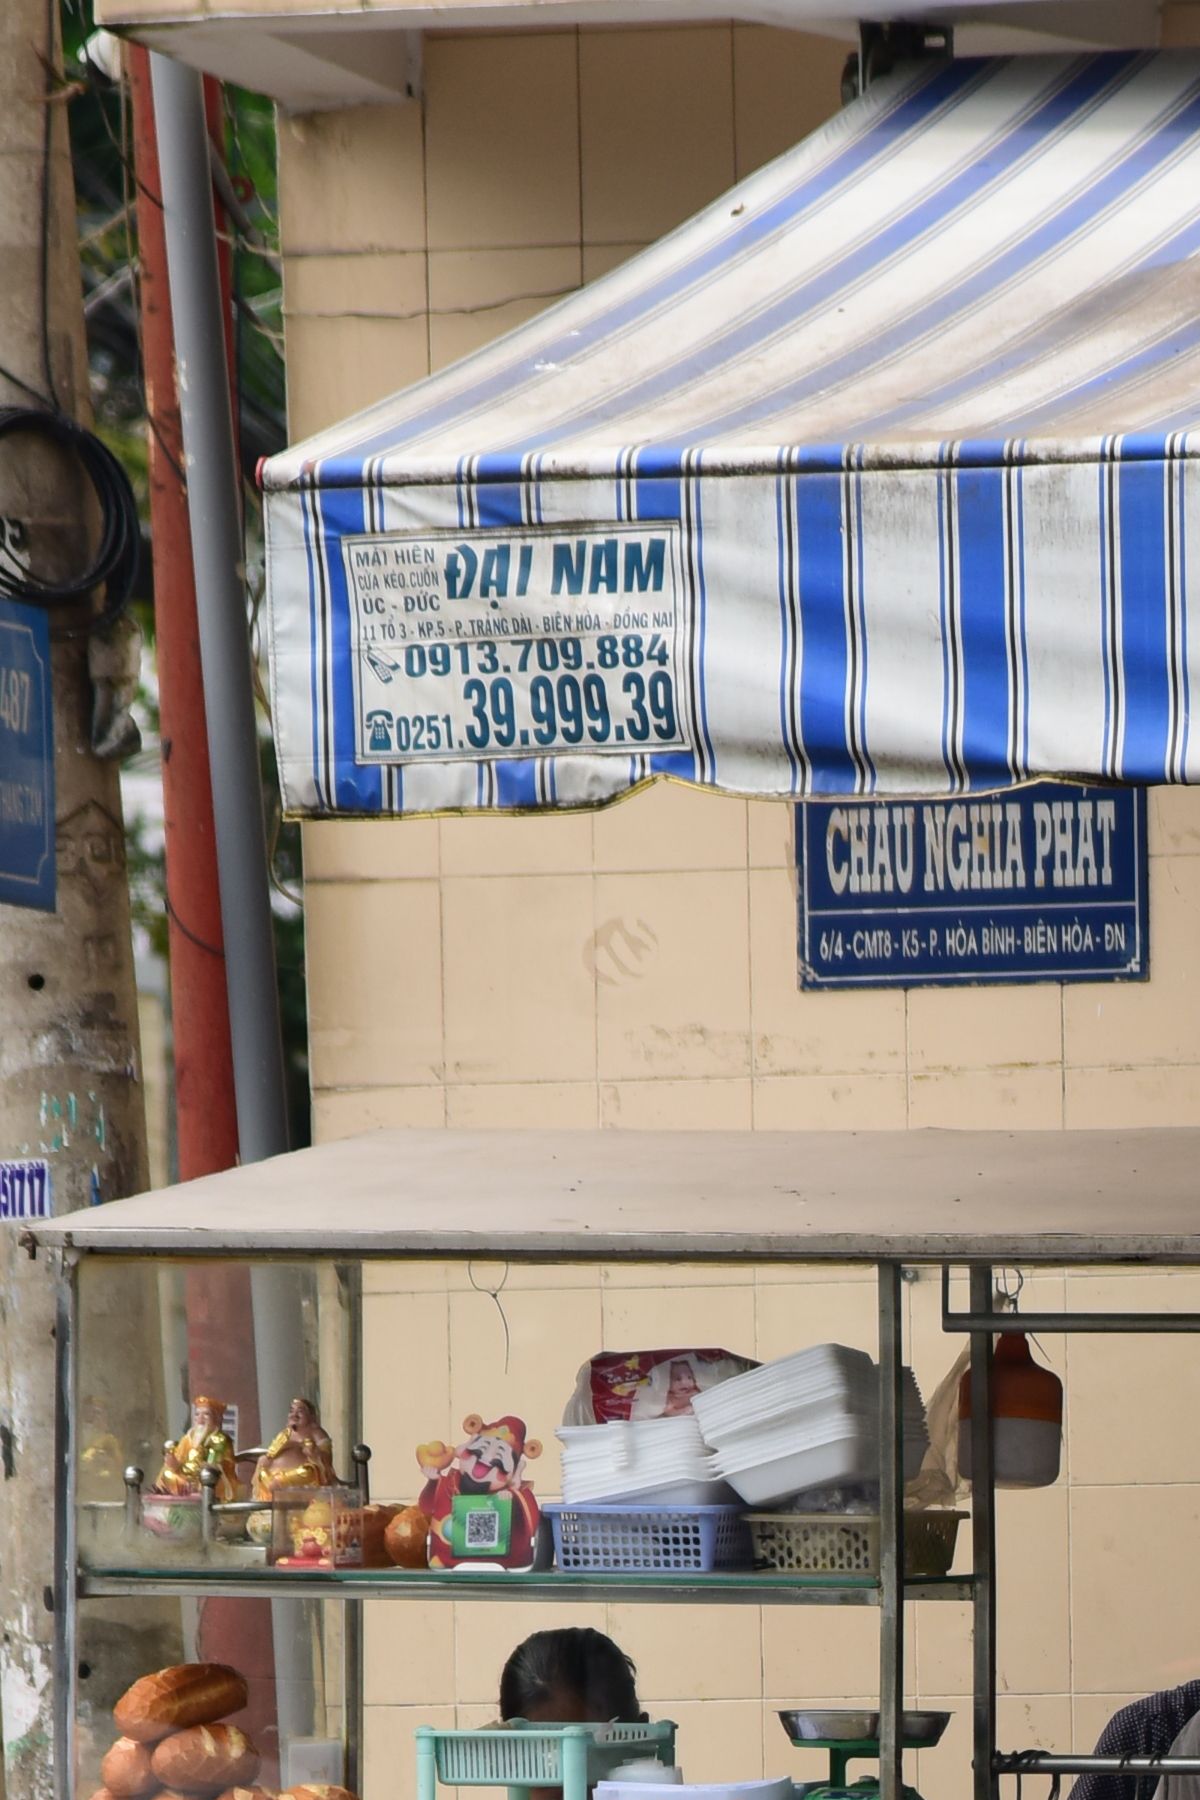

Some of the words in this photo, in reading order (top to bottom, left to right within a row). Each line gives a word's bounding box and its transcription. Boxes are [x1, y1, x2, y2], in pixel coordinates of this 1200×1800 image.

[395, 545, 435, 564] HIÊN
[444, 543, 533, 609] ĐẠI
[551, 539, 666, 595] NAM
[363, 625, 375, 640] 11
[400, 622, 407, 639] 3
[418, 621, 445, 639] KP.5
[543, 611, 572, 633] BIÊN
[576, 608, 601, 631] HÒA
[652, 612, 673, 628] NAI
[405, 633, 669, 678] 0913.709.884
[1032, 787, 1116, 889] PHÁT
[820, 929, 843, 963] 6/4
[853, 929, 892, 959] CMT8
[902, 928, 919, 958] K5
[929, 928, 941, 957] P.
[946, 919, 979, 956] HÒA
[982, 920, 1015, 955] BÌNH
[1024, 918, 1057, 954] BIÊN
[1061, 916, 1094, 953] HÒA
[1104, 923, 1126, 951] ĐN
